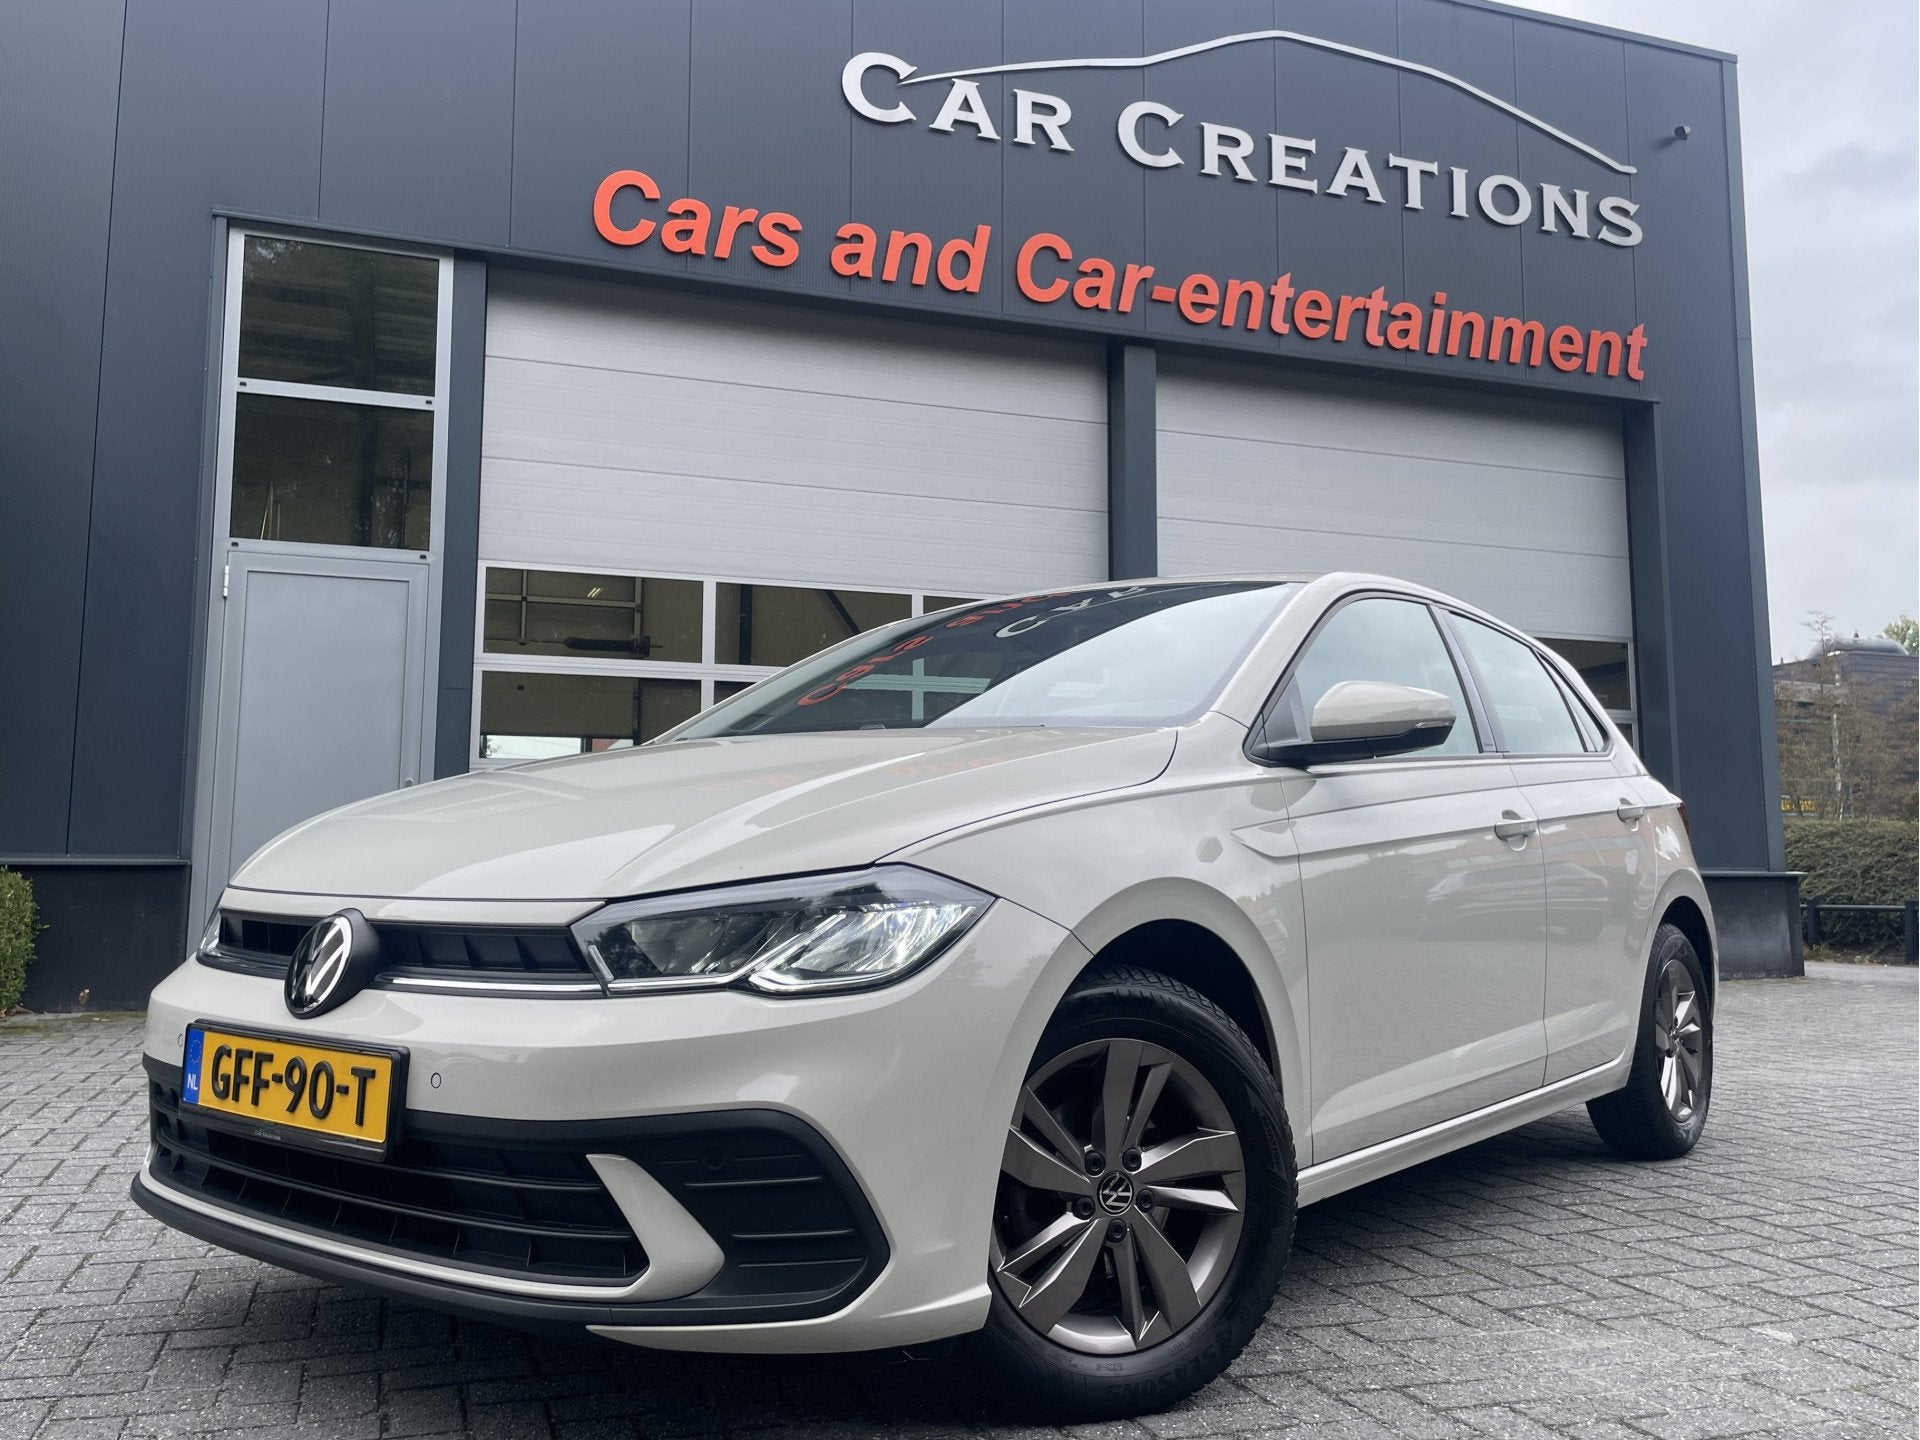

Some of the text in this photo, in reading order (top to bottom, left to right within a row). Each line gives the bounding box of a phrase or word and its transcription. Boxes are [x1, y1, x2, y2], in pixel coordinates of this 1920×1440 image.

[842, 51, 1643, 247] CAR CREATIONS
[593, 169, 1647, 380] Cars and Car-entertainment
[187, 1073, 198, 1091] NL
[211, 1044, 376, 1127] GFF-90-T
